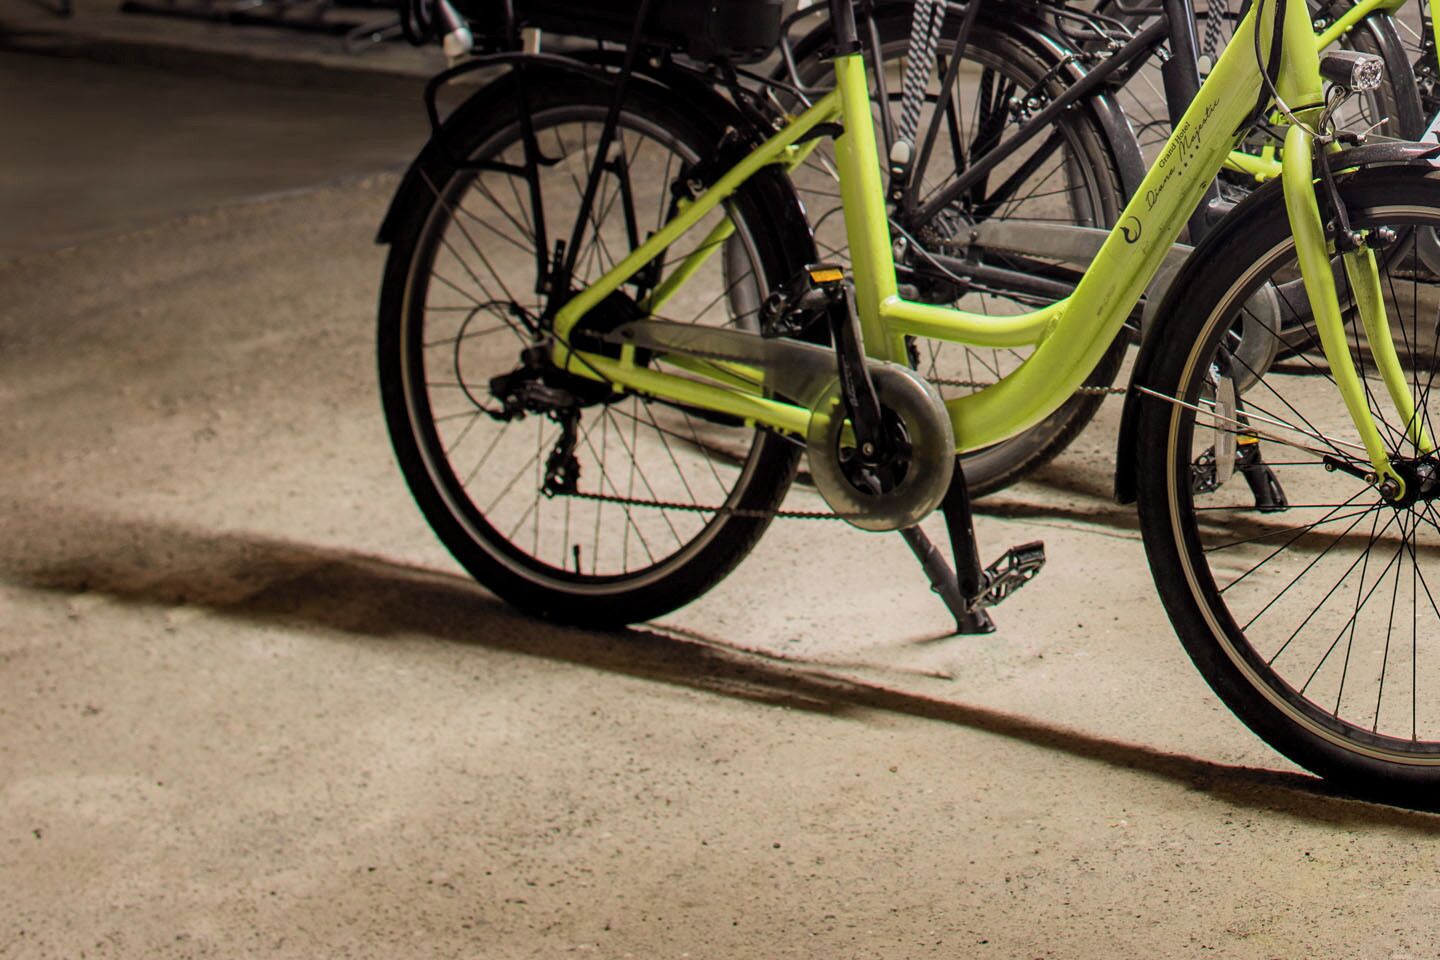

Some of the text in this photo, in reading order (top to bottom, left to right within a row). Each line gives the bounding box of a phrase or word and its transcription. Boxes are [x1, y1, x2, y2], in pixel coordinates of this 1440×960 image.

[1146, 98, 1220, 211] Diana Majestic
[1159, 121, 1191, 168] Grand Hotel
